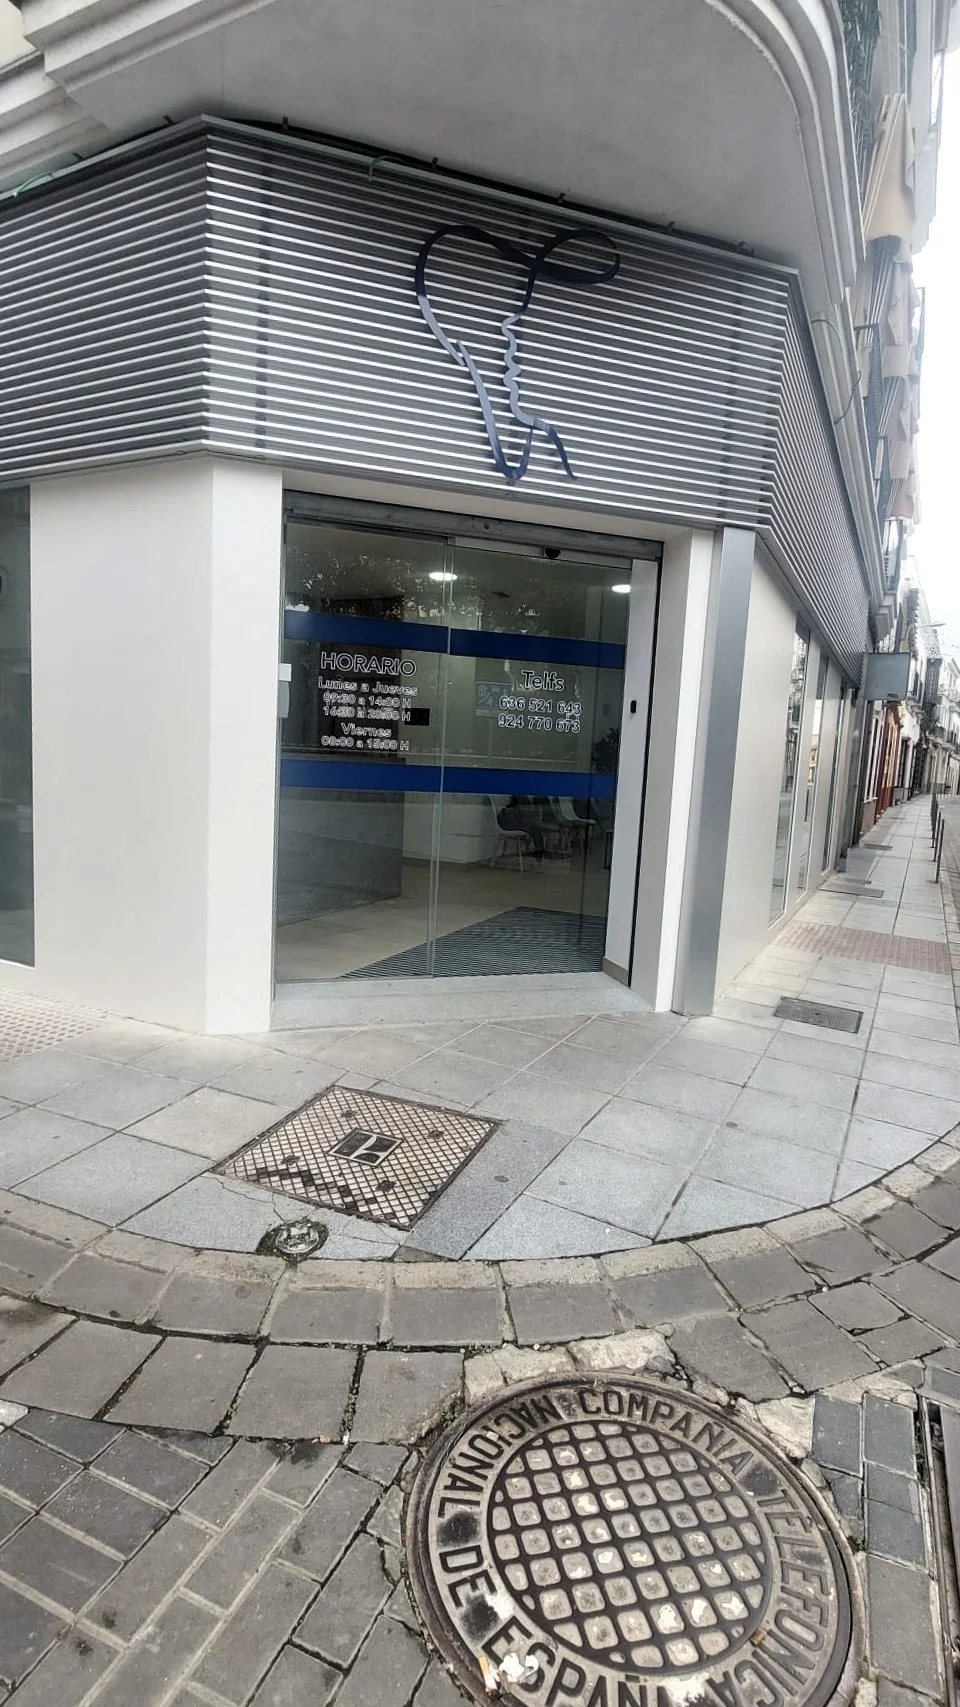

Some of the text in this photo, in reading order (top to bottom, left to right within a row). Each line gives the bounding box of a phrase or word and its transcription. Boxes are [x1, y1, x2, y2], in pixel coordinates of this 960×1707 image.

[320, 651, 416, 677] HORARIO
[318, 676, 418, 696] Lunes a Jueves
[521, 669, 564, 691] Telfs
[358, 696, 365, 706] a
[369, 695, 400, 707] 14:00
[401, 698, 412, 708] H
[500, 695, 581, 715] 636 521 643
[323, 705, 411, 722] 16:30 a 20:00 H
[498, 713, 580, 733] 924 770 673
[341, 722, 392, 737] Viernes
[356, 739, 364, 748] a
[400, 740, 410, 751] H
[437, 1394, 564, 1519] NACIONAL
[438, 1543, 496, 1611] DE
